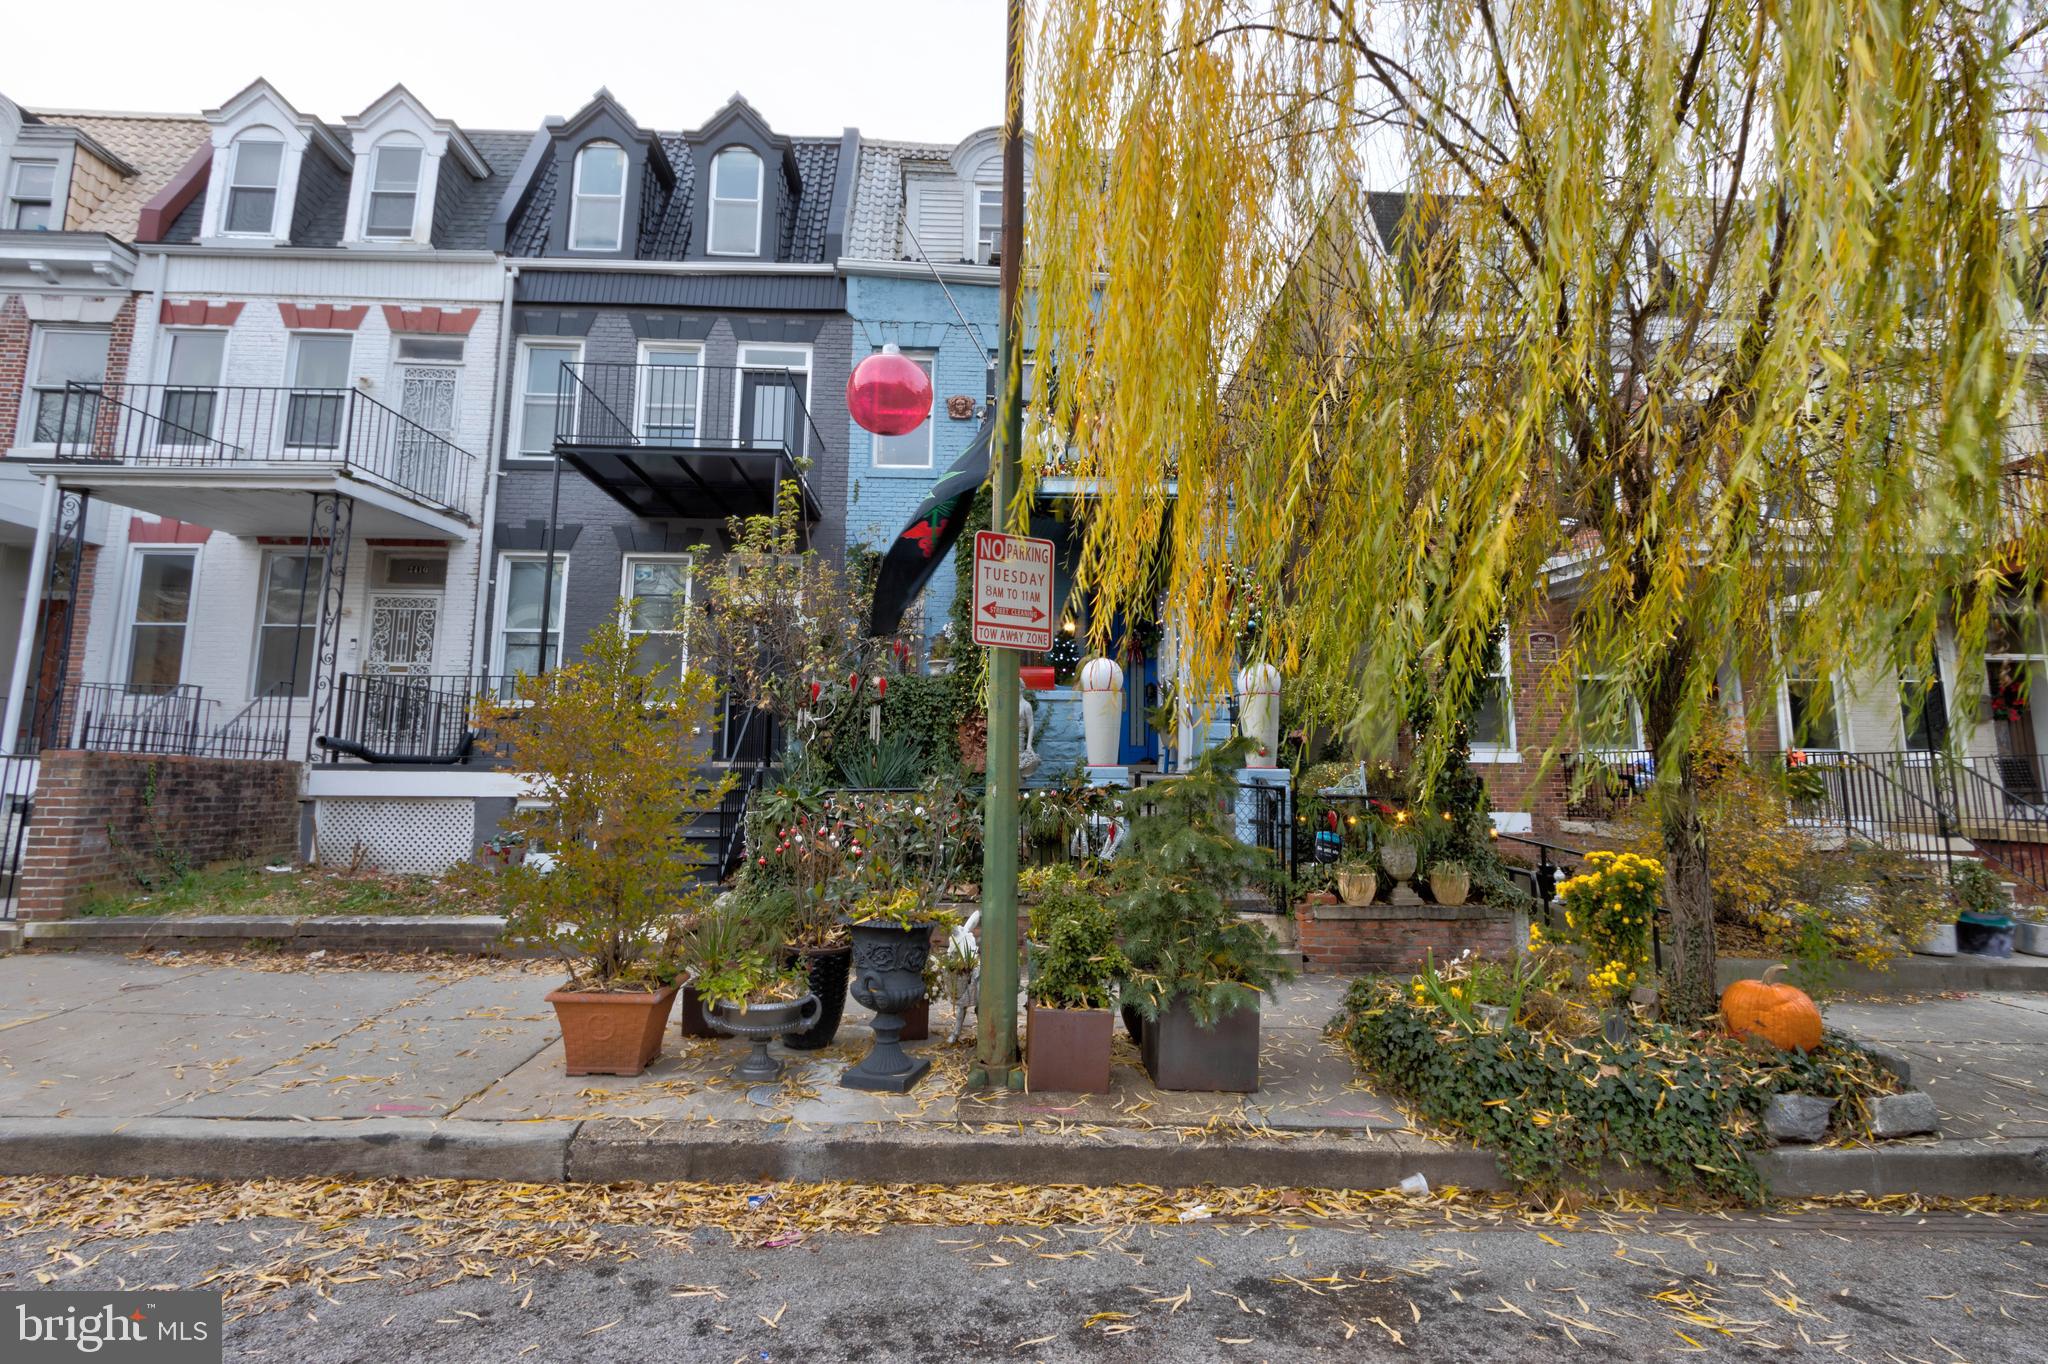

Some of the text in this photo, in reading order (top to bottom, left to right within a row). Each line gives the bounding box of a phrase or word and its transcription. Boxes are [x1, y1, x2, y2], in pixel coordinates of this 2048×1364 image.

[980, 537, 1048, 564] NO PARKING
[984, 566, 1045, 587] TUESDAY
[985, 585, 1004, 598] 8AM
[1007, 588, 1018, 600] TO
[990, 606, 1037, 618] STREET CLEANING
[979, 627, 1048, 645] TOW AWAY ZONE
